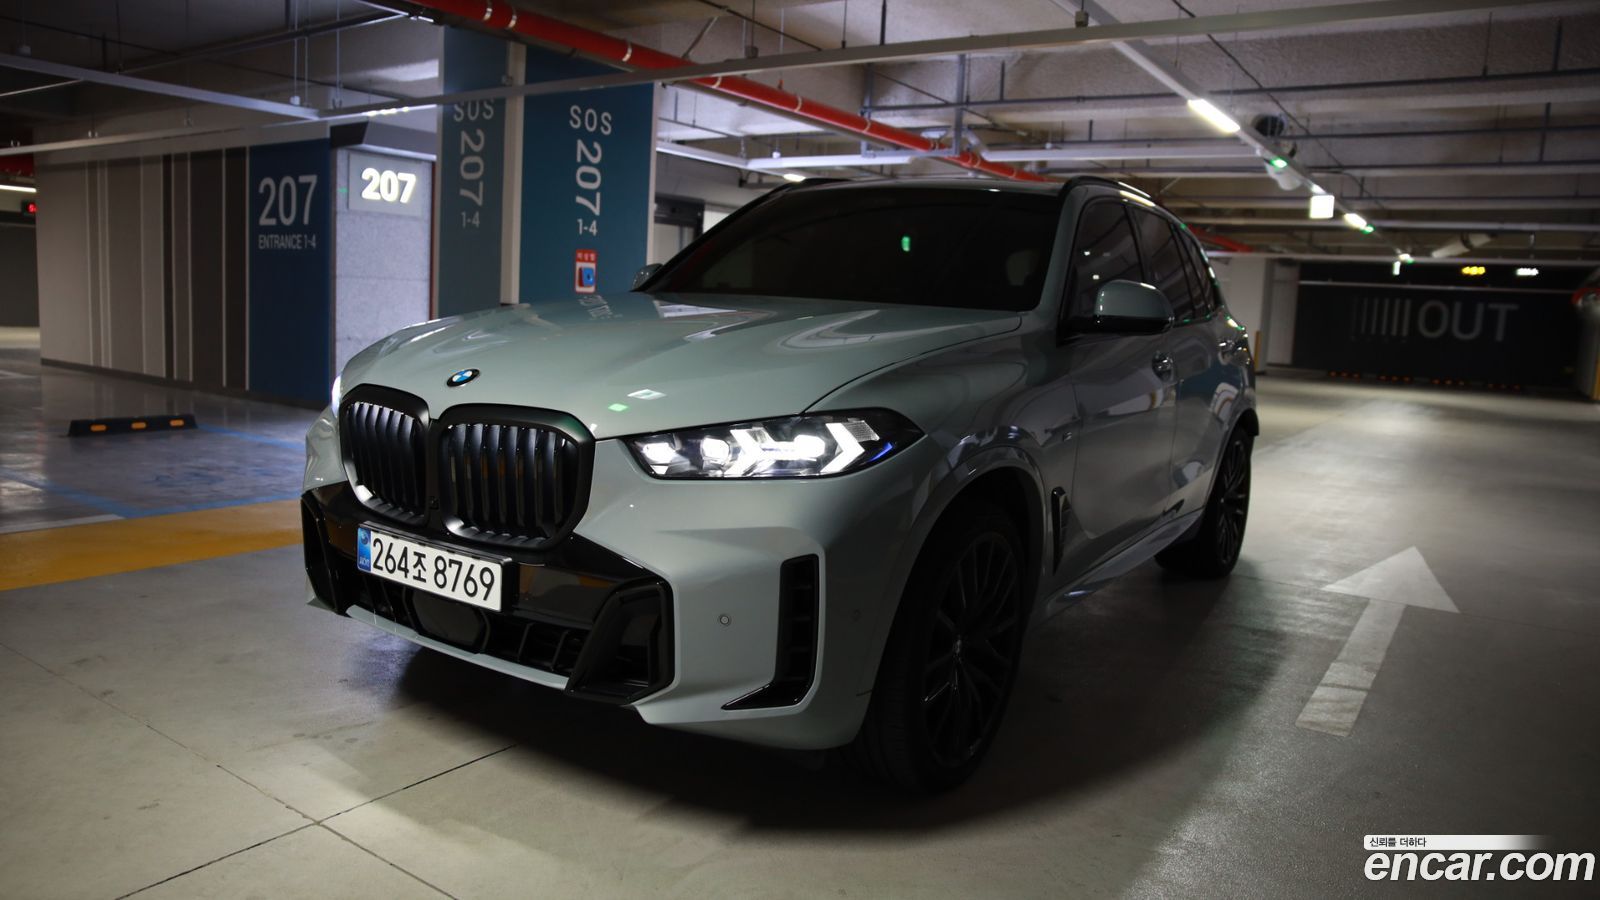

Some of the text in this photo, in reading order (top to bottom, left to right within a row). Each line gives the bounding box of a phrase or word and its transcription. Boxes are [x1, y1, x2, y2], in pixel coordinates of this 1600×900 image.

[453, 99, 494, 122] SOS
[569, 104, 612, 135] SOS
[360, 167, 417, 204] 207
[460, 129, 485, 206] 207
[576, 139, 602, 216] 207
[259, 174, 318, 226] 207
[461, 211, 480, 228] 1-4
[577, 218, 598, 236] 1-4
[258, 234, 302, 250] ENTRANCE
[1417, 299, 1519, 341] OUT
[373, 537, 495, 601] 264조 8769
